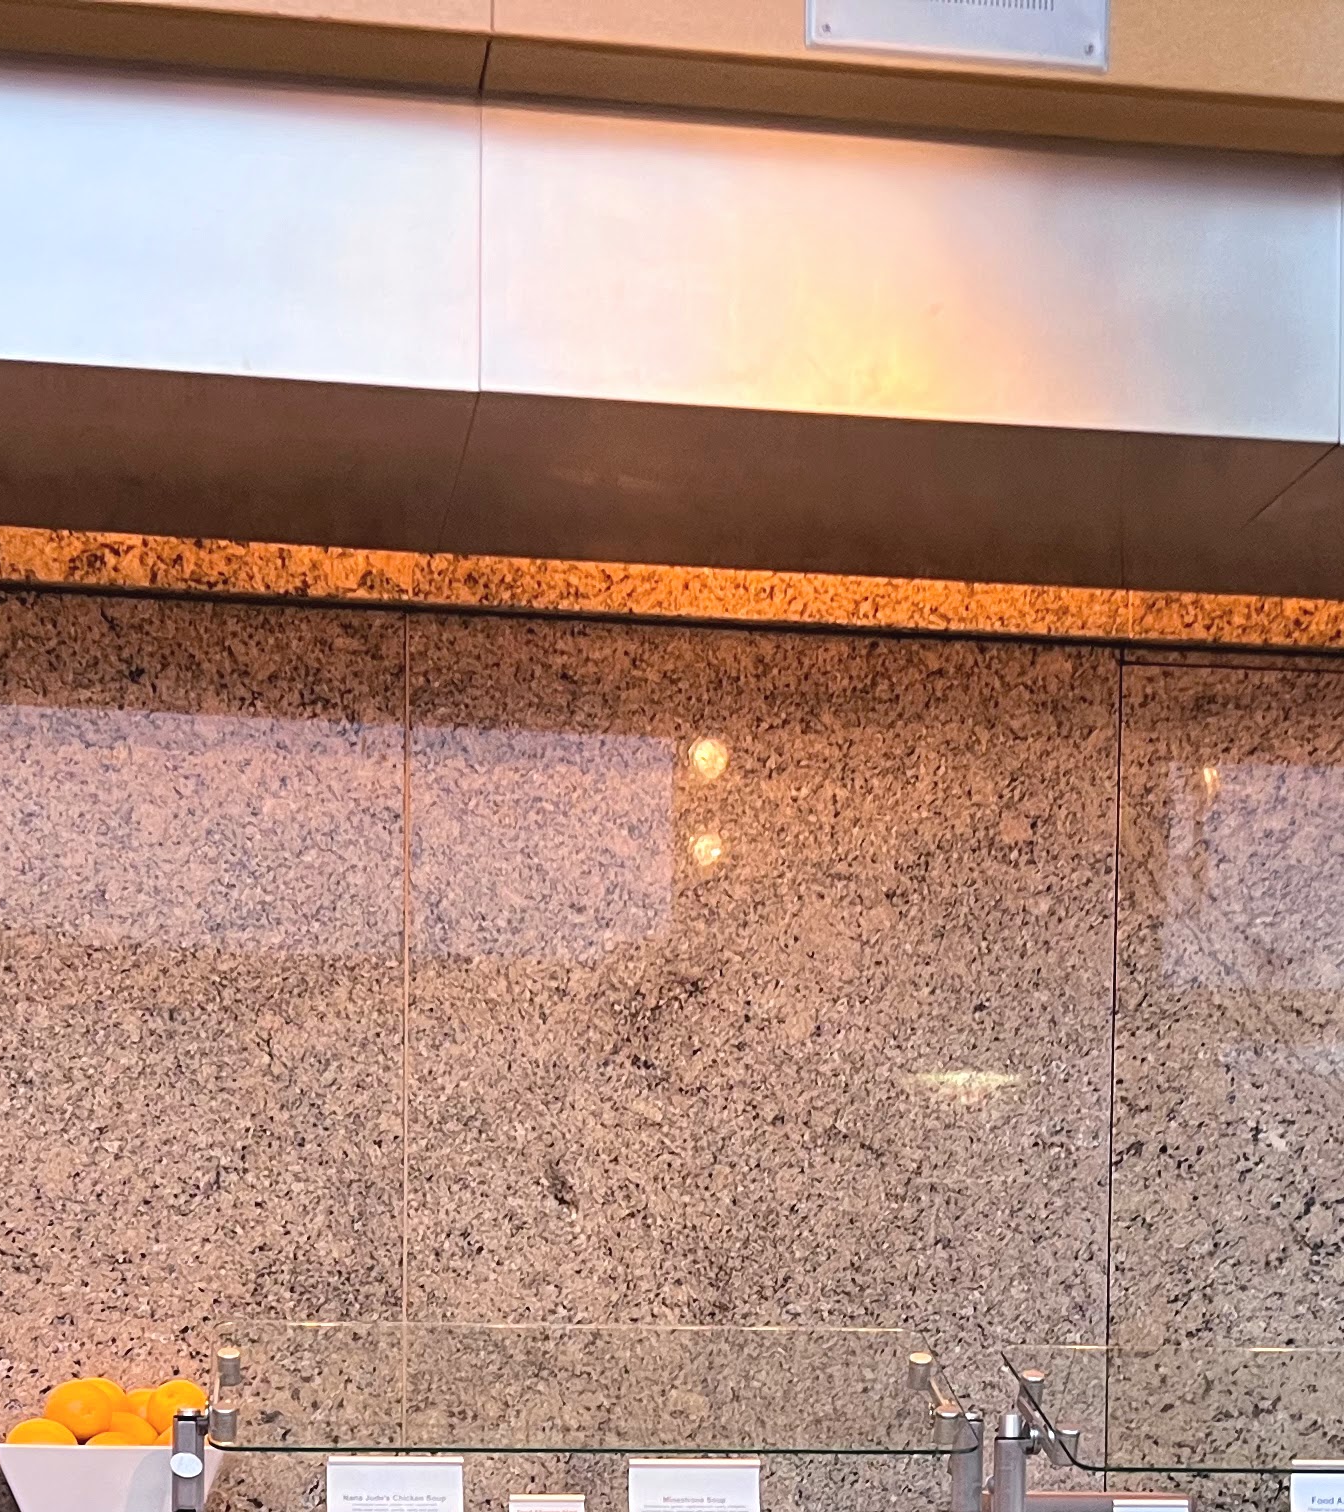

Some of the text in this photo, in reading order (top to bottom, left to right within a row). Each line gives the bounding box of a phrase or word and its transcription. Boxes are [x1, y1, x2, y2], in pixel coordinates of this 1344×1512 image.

[392, 1494, 425, 1502] Chicken
[426, 1494, 447, 1503] Soup
[1311, 1496, 1335, 1505] Food
